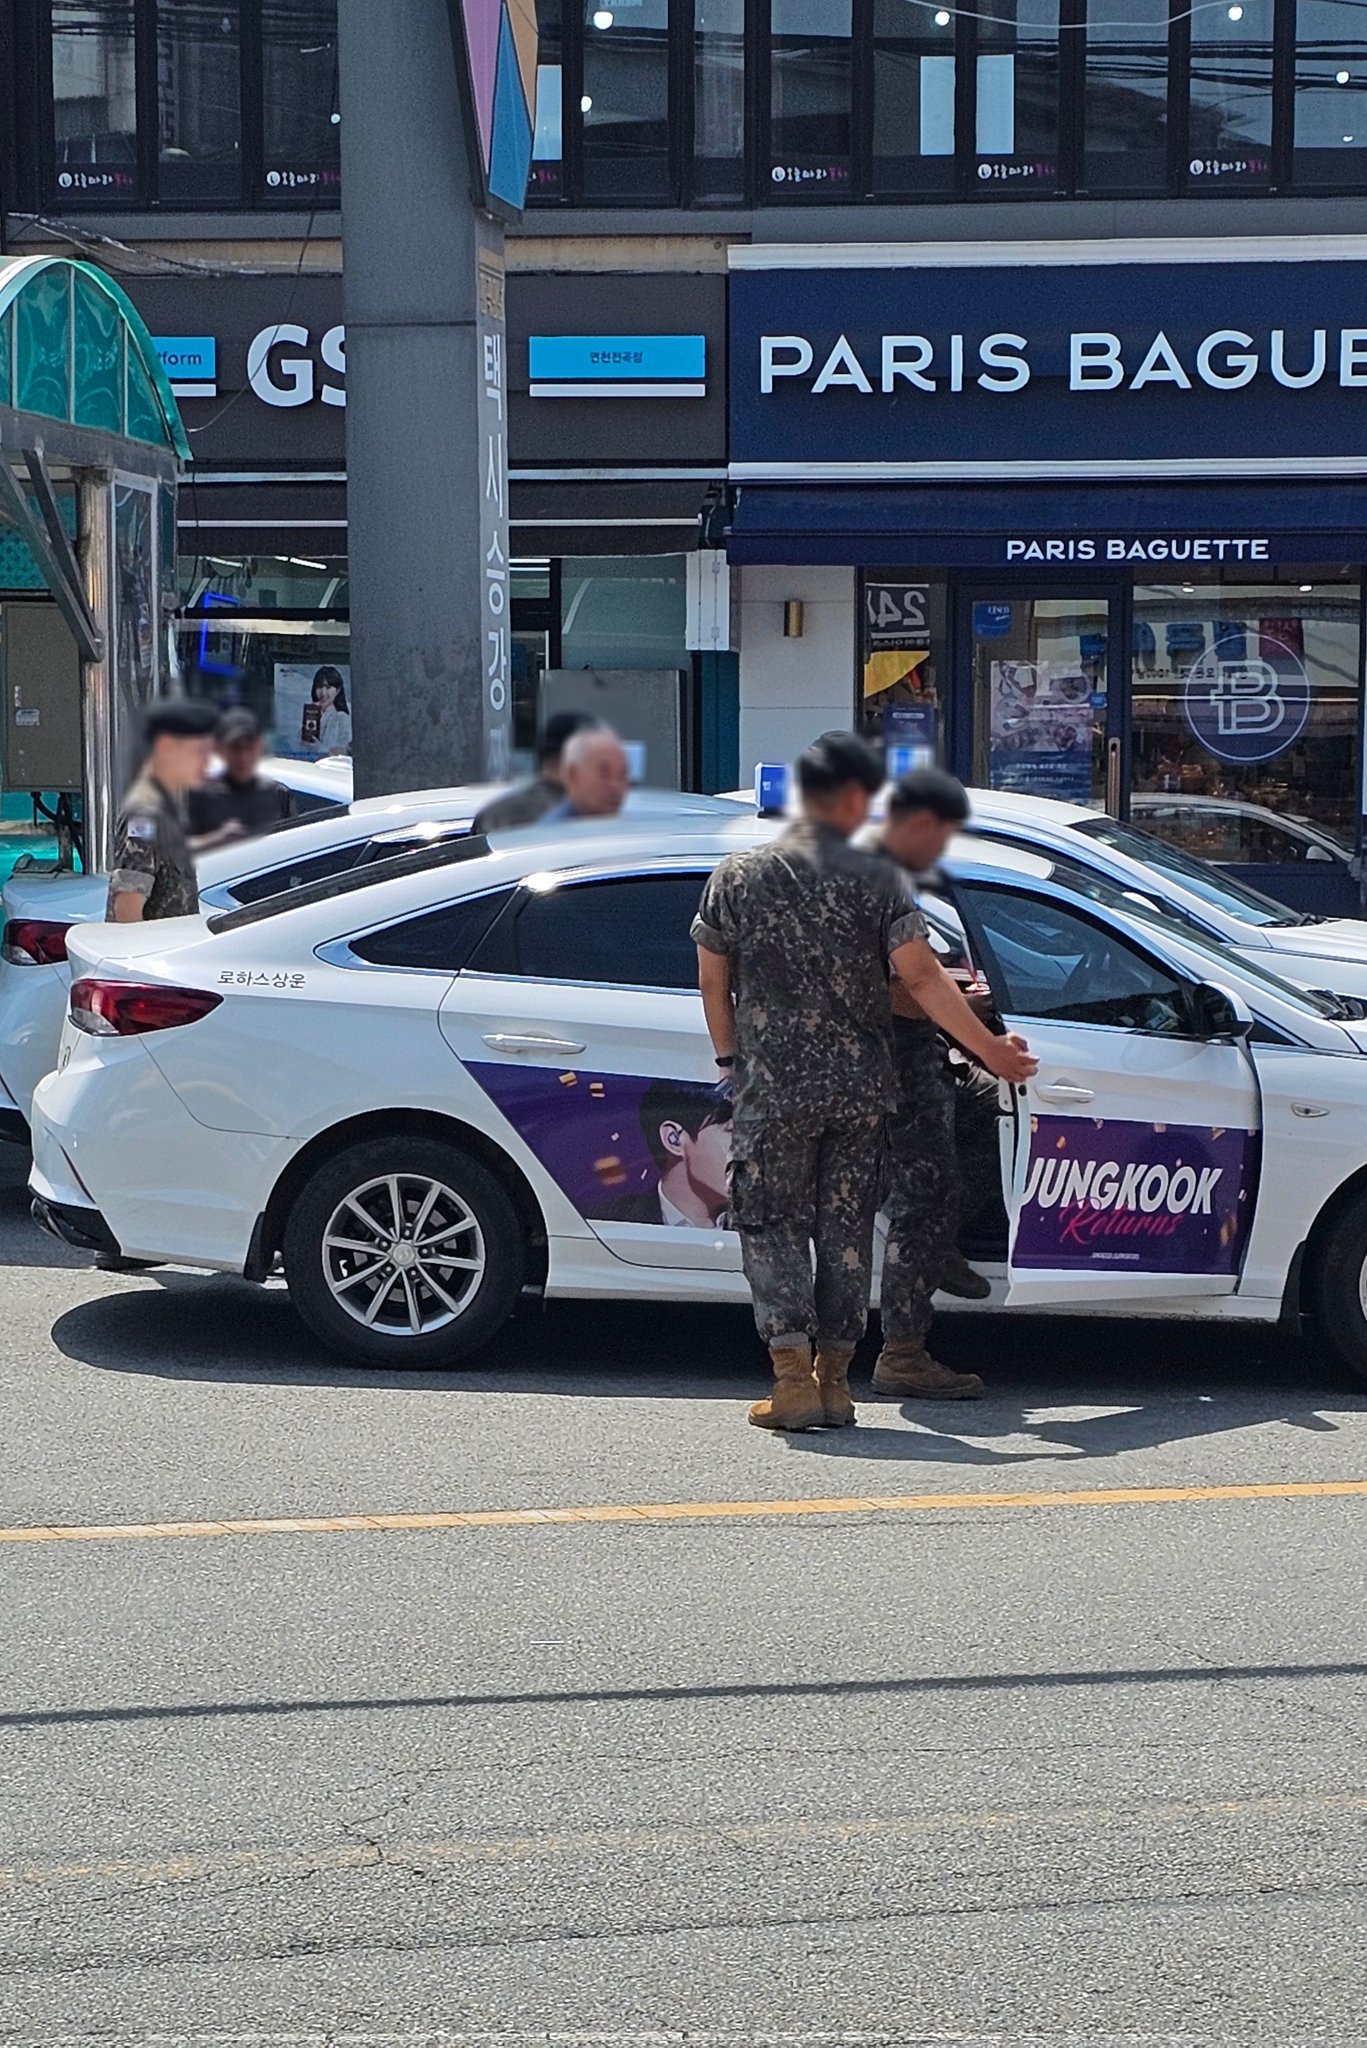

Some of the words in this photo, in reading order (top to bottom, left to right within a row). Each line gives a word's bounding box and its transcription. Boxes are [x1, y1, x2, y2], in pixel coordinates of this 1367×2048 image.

[760, 333, 1031, 393] PARIS
[1006, 540, 1096, 560] PARIS
[1106, 539, 1269, 560] BAGUETTE
[217, 970, 306, 989] 로하스상운
[1021, 1157, 1224, 1215] JUNGKOOK
[1058, 1196, 1185, 1245] Returns
